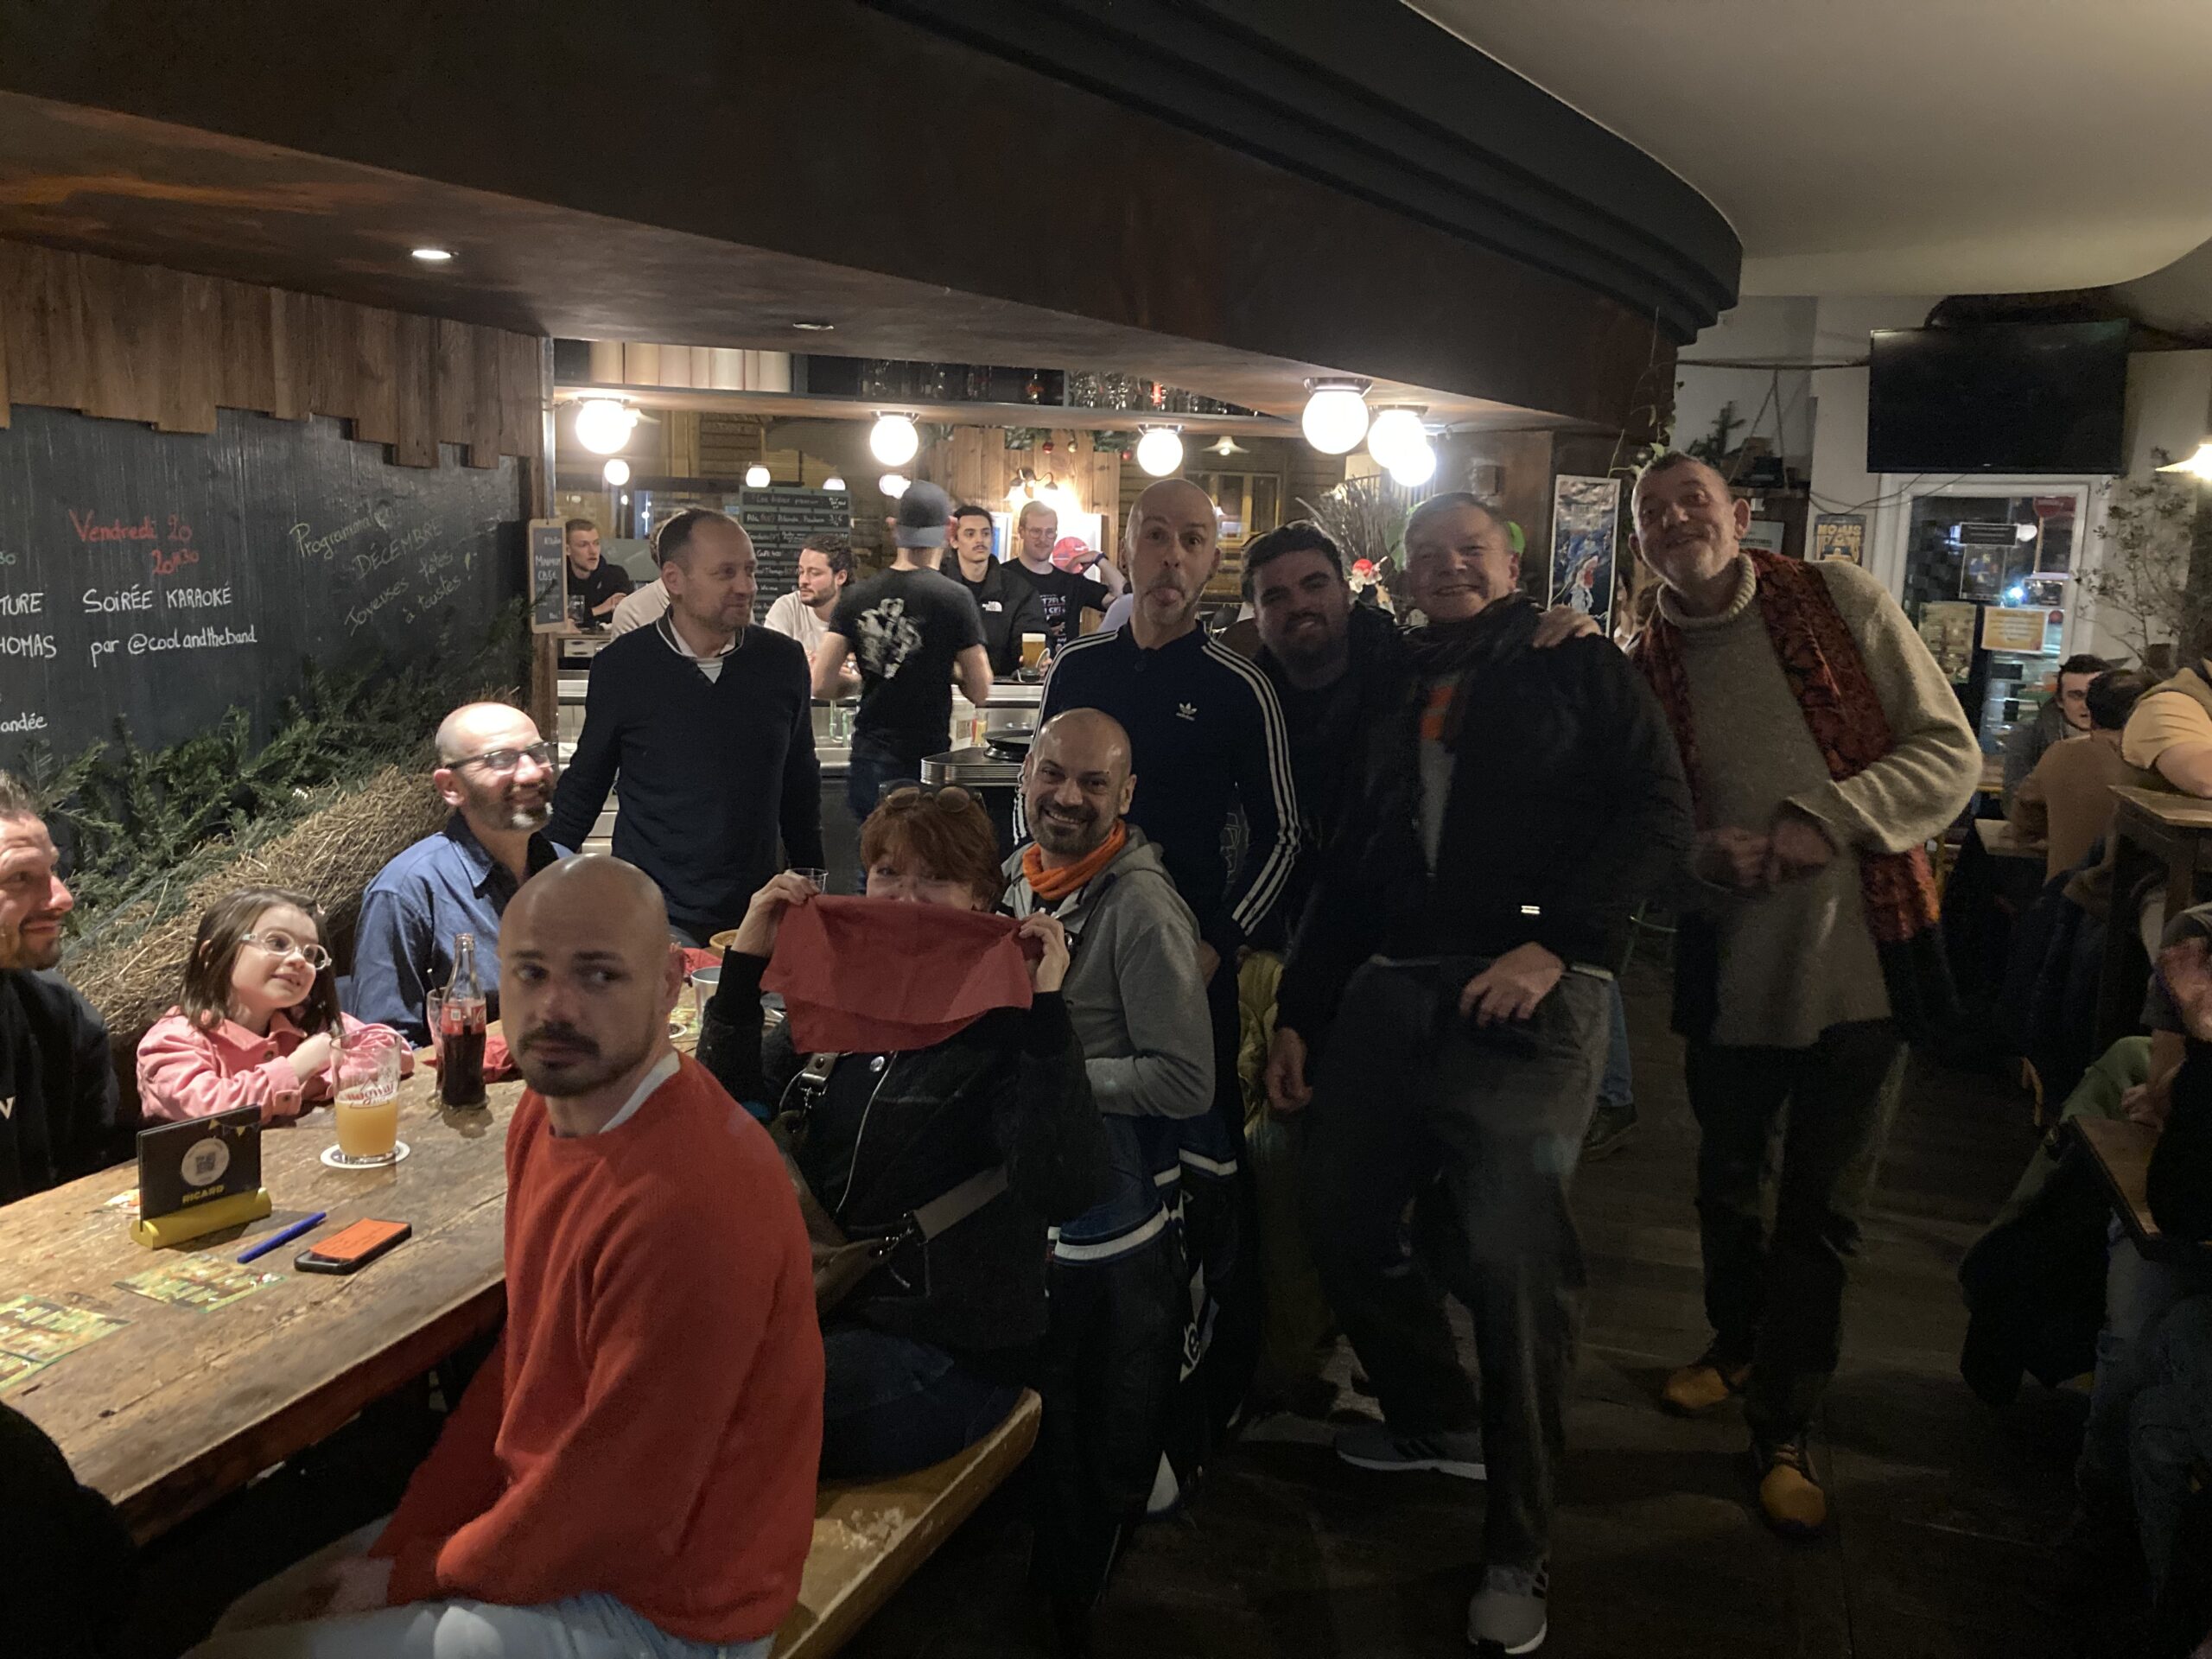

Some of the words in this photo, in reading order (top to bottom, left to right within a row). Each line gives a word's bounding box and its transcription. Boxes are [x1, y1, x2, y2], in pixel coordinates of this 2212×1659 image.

[69, 509, 157, 542] Vendredi
[352, 517, 442, 579] DÉCEMBRE
[166, 580, 232, 609] KARAOKÉ
[91, 639, 119, 668] par
[182, 1185, 225, 1204] RICARD
